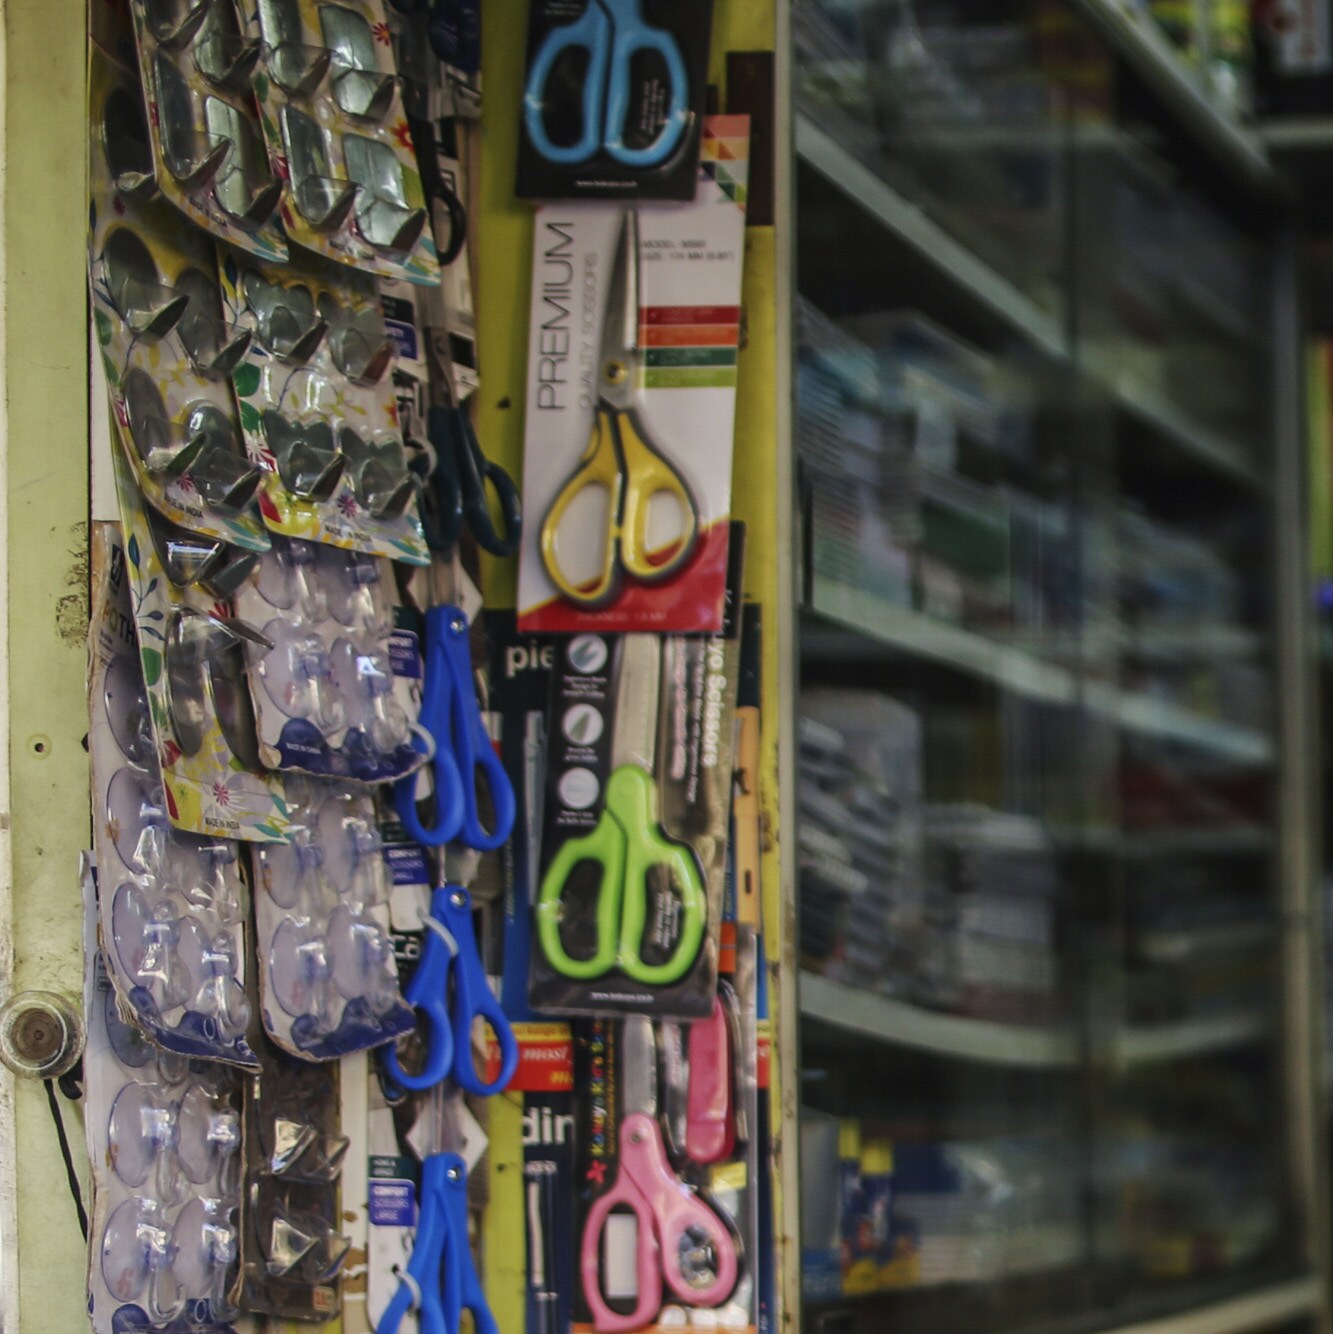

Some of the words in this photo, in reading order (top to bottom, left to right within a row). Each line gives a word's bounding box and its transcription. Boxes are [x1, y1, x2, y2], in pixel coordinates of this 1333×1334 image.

[537, 221, 576, 410] PREMIUM
[185, 505, 204, 519] INDIA
[504, 641, 554, 677] pie
[701, 674, 727, 769] Scissors
[205, 816, 219, 828] MADE
[225, 819, 241, 830] INDIA
[374, 1185, 409, 1198] COMFORT
